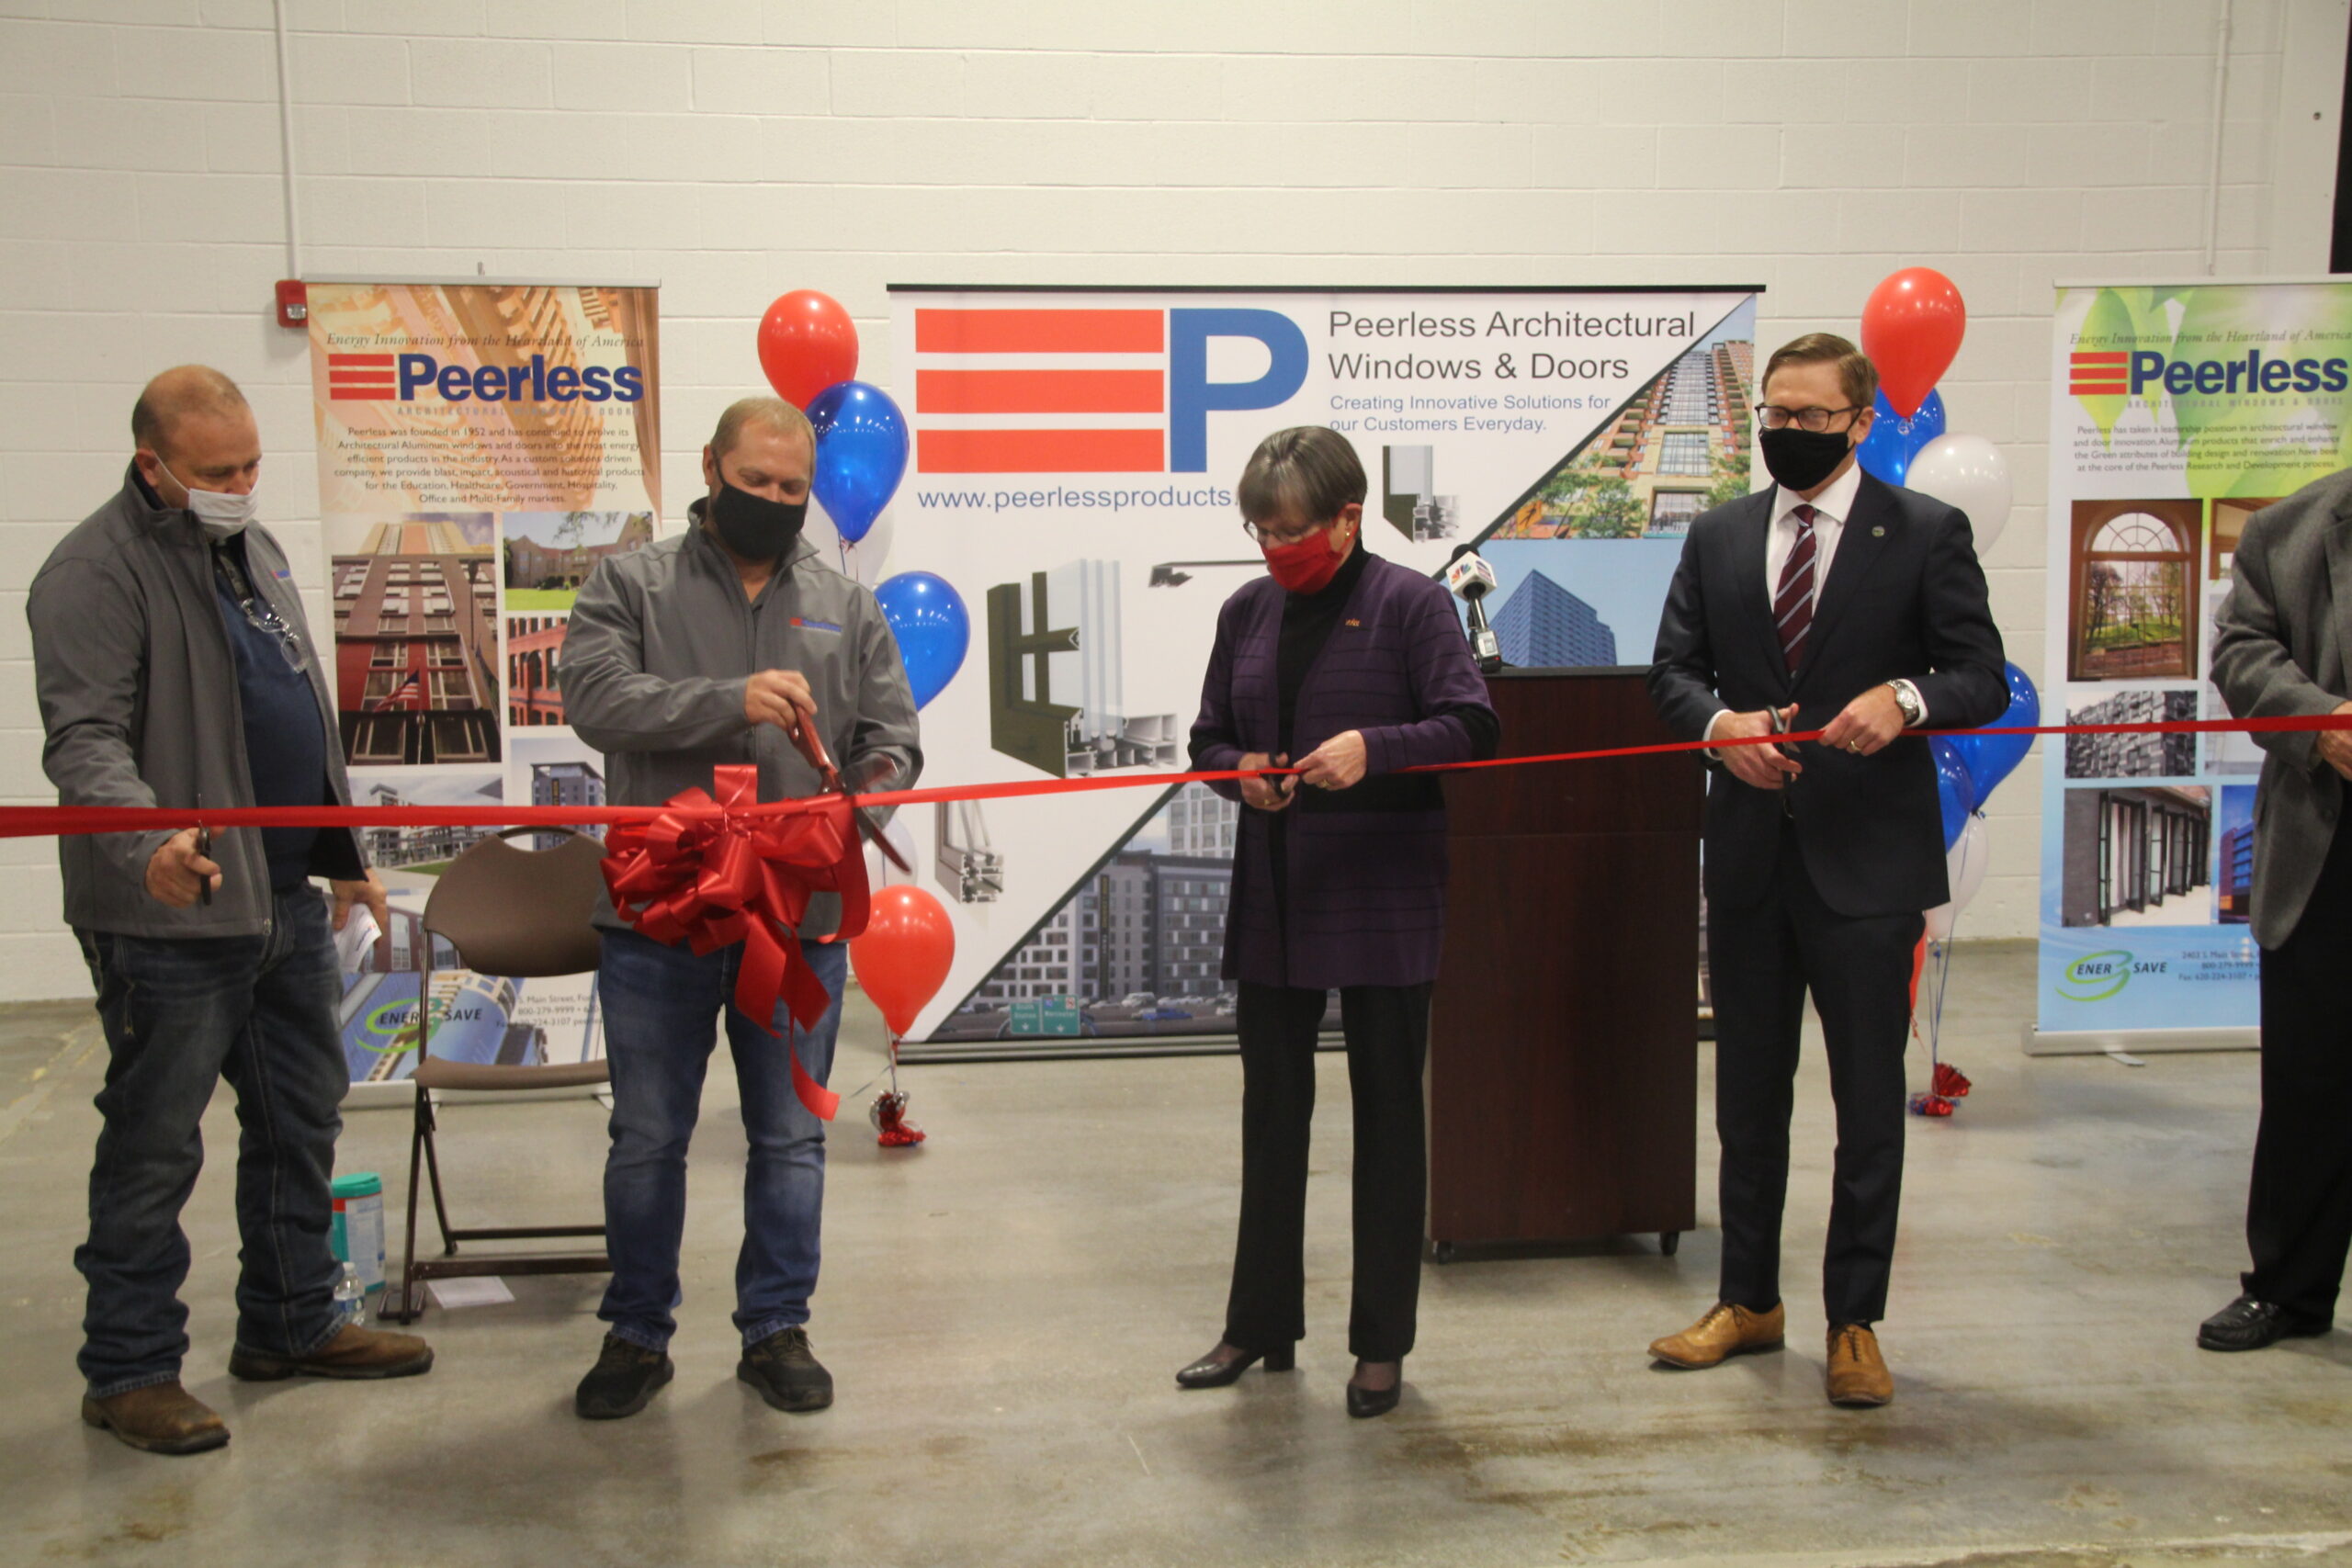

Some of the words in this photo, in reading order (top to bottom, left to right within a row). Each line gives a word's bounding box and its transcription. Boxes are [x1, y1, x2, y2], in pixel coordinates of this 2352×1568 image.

[1329, 310, 1476, 337] Peerless
[1486, 310, 1694, 337] Architectural
[327, 333, 370, 347] Energy
[375, 333, 444, 345] Innovation
[448, 334, 478, 346] from
[483, 334, 500, 346] the
[505, 335, 571, 346] Heartland
[576, 335, 589, 349] of
[592, 335, 643, 347] America
[2070, 333, 2108, 347] Energy
[2112, 333, 2172, 344] Innovation
[2177, 332, 2202, 344] from
[2206, 331, 2221, 343] the
[2227, 331, 2286, 343] Heartland
[2290, 331, 2301, 344] of
[2304, 330, 2352, 341] America
[1328, 353, 1481, 379] Windows
[1495, 352, 1517, 379] &
[1532, 353, 1629, 379] Doors
[2132, 349, 2348, 395] Peerless
[399, 353, 643, 402] Peerless
[1329, 395, 1404, 412] Creating
[1409, 395, 1498, 410] Innovative
[1503, 394, 1582, 410] Solutions
[1588, 394, 1611, 409] for
[348, 427, 386, 436] Peerless
[410, 427, 448, 436] founded
[451, 427, 459, 436] in
[464, 427, 485, 436] 1952
[489, 427, 504, 436] and
[508, 427, 522, 436] has
[526, 427, 571, 436] continued
[574, 427, 583, 436] to
[588, 427, 615, 436] evolve
[618, 427, 628, 436] its
[1329, 419, 1359, 431] our
[1364, 416, 1457, 431] Customers
[1464, 416, 1547, 434] Everyday.
[2077, 426, 2111, 434] Peerless
[2113, 426, 2127, 434] has
[2161, 425, 2201, 435] leadership
[2203, 424, 2236, 434] position
[2250, 423, 2303, 432] architectural
[338, 441, 399, 449] Architectural
[401, 441, 448, 449] Aluminum
[452, 441, 492, 449] windows
[495, 441, 512, 449] and
[515, 441, 542, 449] doors
[546, 441, 562, 449] into
[566, 441, 580, 449] the
[584, 441, 606, 449] most
[610, 442, 639, 451] energy
[2074, 439, 2088, 447] and
[2202, 436, 2238, 446] products
[2242, 436, 2257, 445] that
[347, 454, 383, 463] efficient
[387, 454, 428, 465] products
[431, 454, 440, 463] in
[443, 454, 458, 463] the
[524, 455, 557, 463] custom
[560, 454, 601, 463] solutions
[605, 454, 631, 463] driven
[2075, 451, 2088, 459] the
[2091, 450, 2117, 458] Green
[2120, 450, 2157, 458] attributes
[2171, 449, 2201, 459] building
[2204, 449, 2230, 459] design
[2233, 448, 2247, 457] and
[2250, 448, 2295, 457] renovation
[2088, 463, 2102, 471] the
[2125, 462, 2133, 470] of
[2136, 462, 2148, 470] the
[2152, 462, 2184, 470] Peerless
[2187, 462, 2223, 470] Research
[2244, 460, 2301, 469] Development
[396, 468, 431, 478] provide
[495, 468, 539, 477] acoustical
[543, 468, 559, 477] and
[561, 468, 602, 477] historical
[605, 468, 645, 478] products
[366, 480, 379, 490] for
[382, 480, 397, 490] the
[419, 493, 447, 502] Office
[449, 494, 467, 502] and
[470, 494, 525, 504] Multi-Family
[2076, 964, 2111, 976] ENER
[2133, 962, 2167, 974] SAVE
[379, 1011, 420, 1025] ENER
[445, 1008, 482, 1021] SAVE
